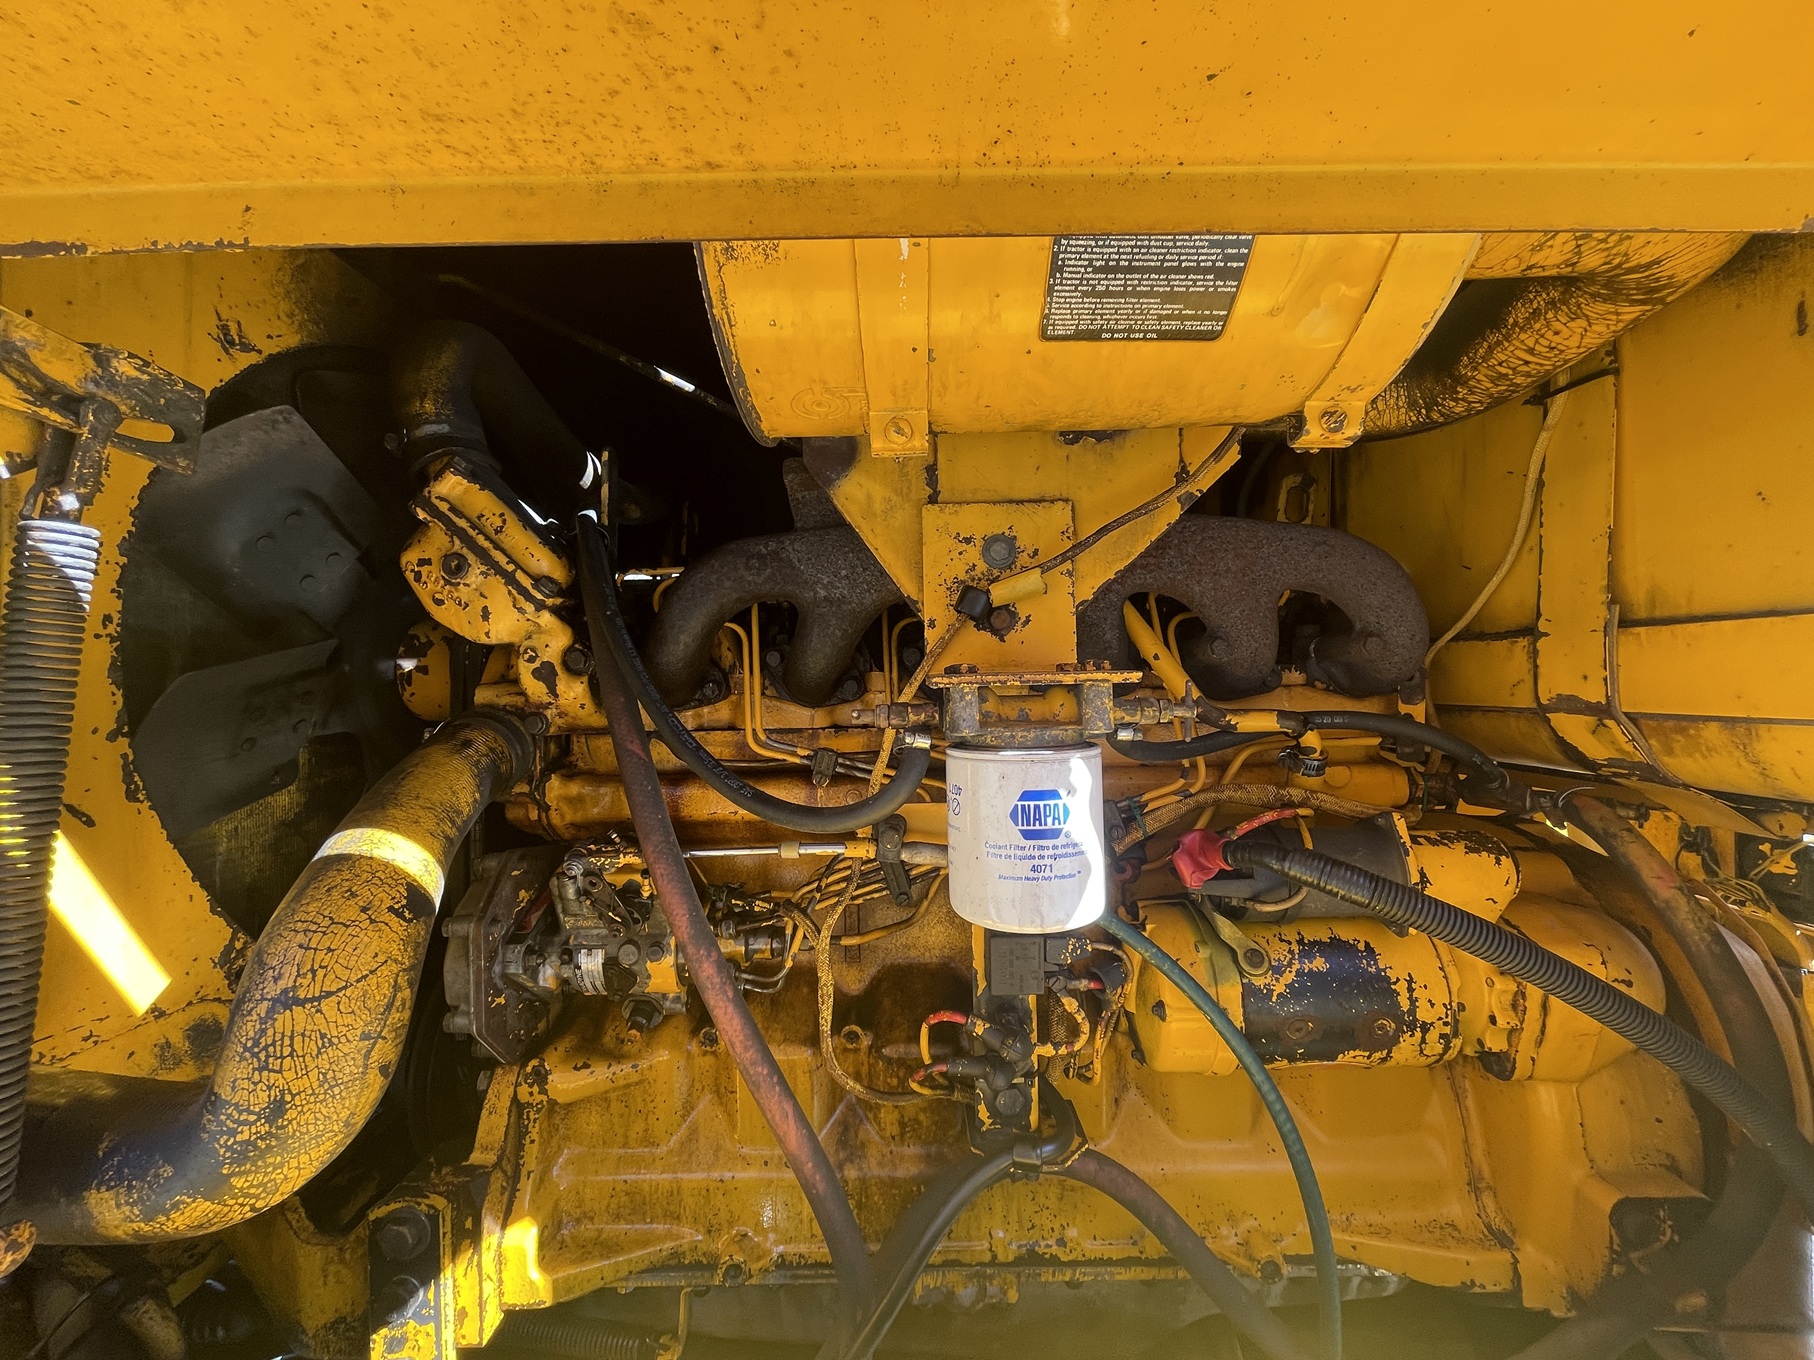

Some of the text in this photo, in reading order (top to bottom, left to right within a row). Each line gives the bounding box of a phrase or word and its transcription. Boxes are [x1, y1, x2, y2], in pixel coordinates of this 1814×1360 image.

[1021, 803, 1061, 826] NAPA
[985, 842, 1008, 850] Coolant
[987, 851, 1002, 859] Filtre
[1014, 853, 1036, 861] liquide
[1030, 864, 1053, 873] 4071
